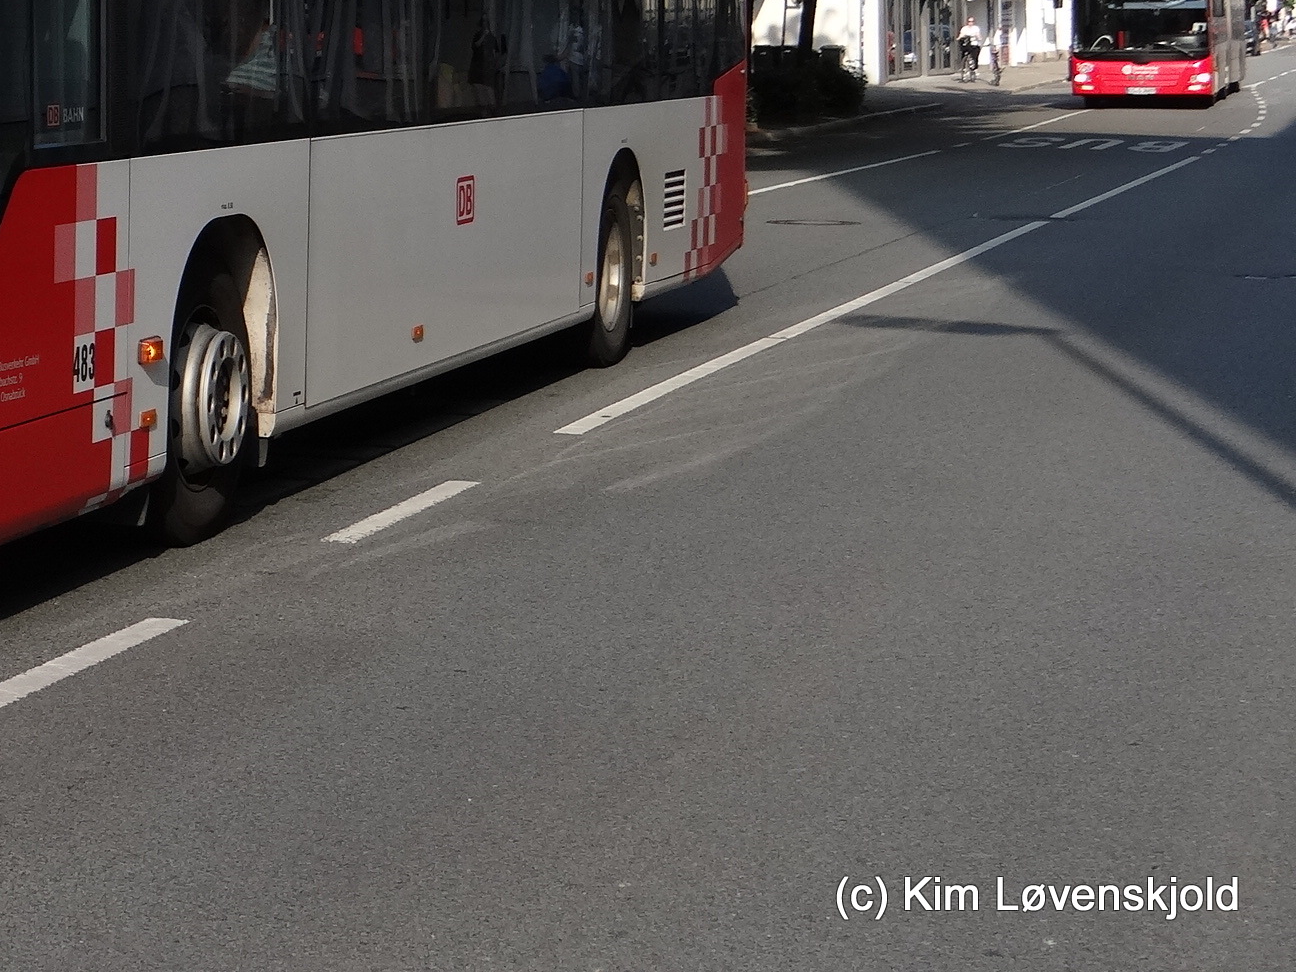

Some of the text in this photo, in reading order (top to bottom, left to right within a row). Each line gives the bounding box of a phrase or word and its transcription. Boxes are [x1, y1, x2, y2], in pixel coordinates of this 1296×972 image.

[63, 107, 84, 123] BAHN
[997, 136, 1191, 153] BUS
[458, 183, 472, 218] DB
[72, 342, 95, 383] 483
